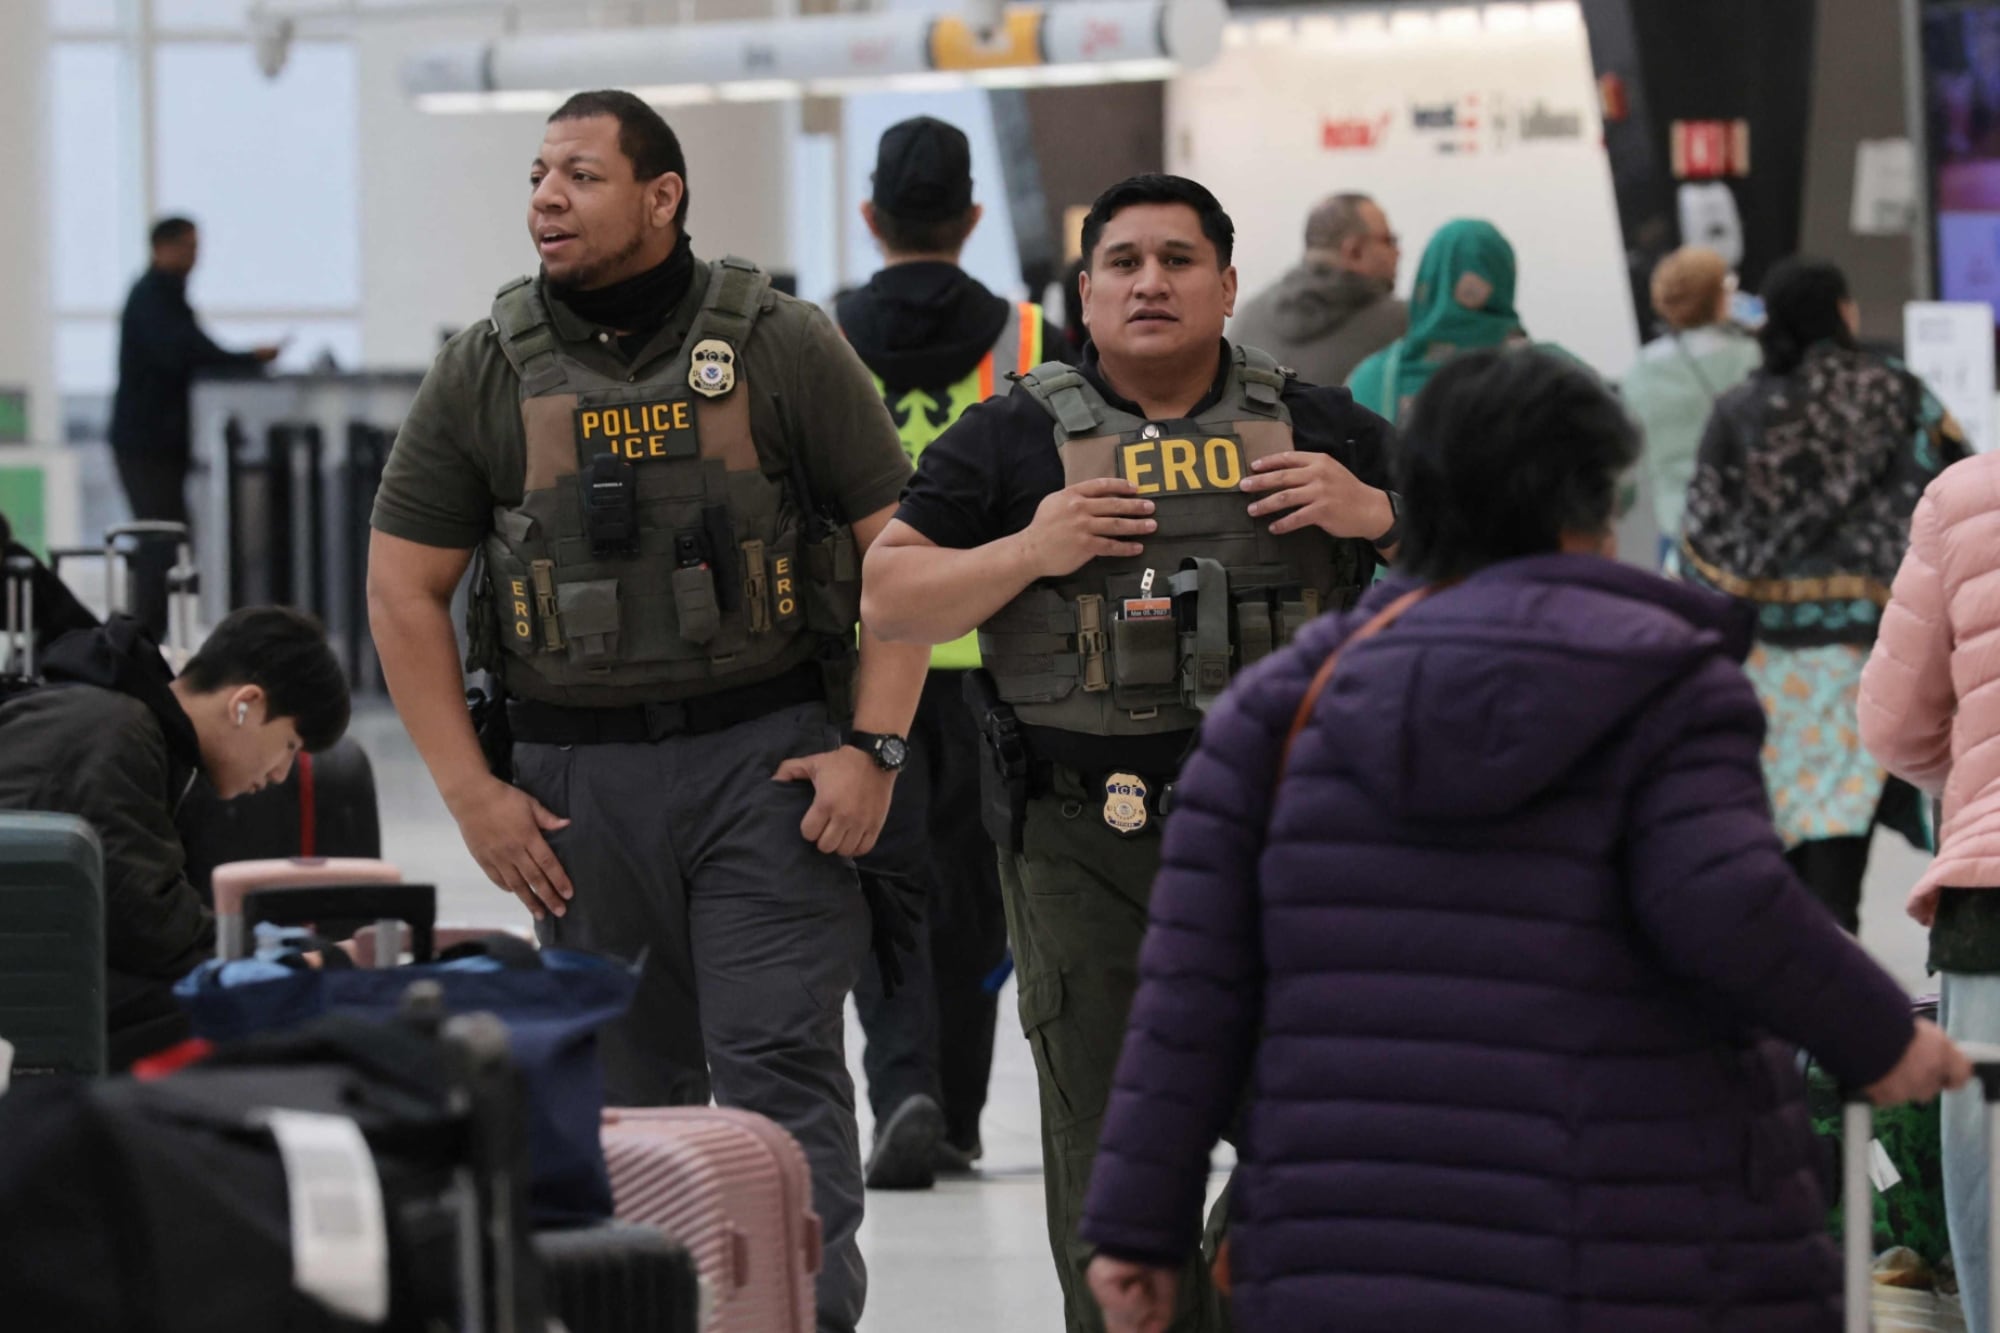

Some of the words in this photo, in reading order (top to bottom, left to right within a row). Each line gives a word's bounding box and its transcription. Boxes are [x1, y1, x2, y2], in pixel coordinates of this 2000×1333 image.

[582, 402, 690, 439] POLICE
[611, 434, 667, 459] ICE
[1123, 437, 1241, 494] ERO
[511, 580, 529, 637] ERO
[776, 557, 794, 615] ERO
